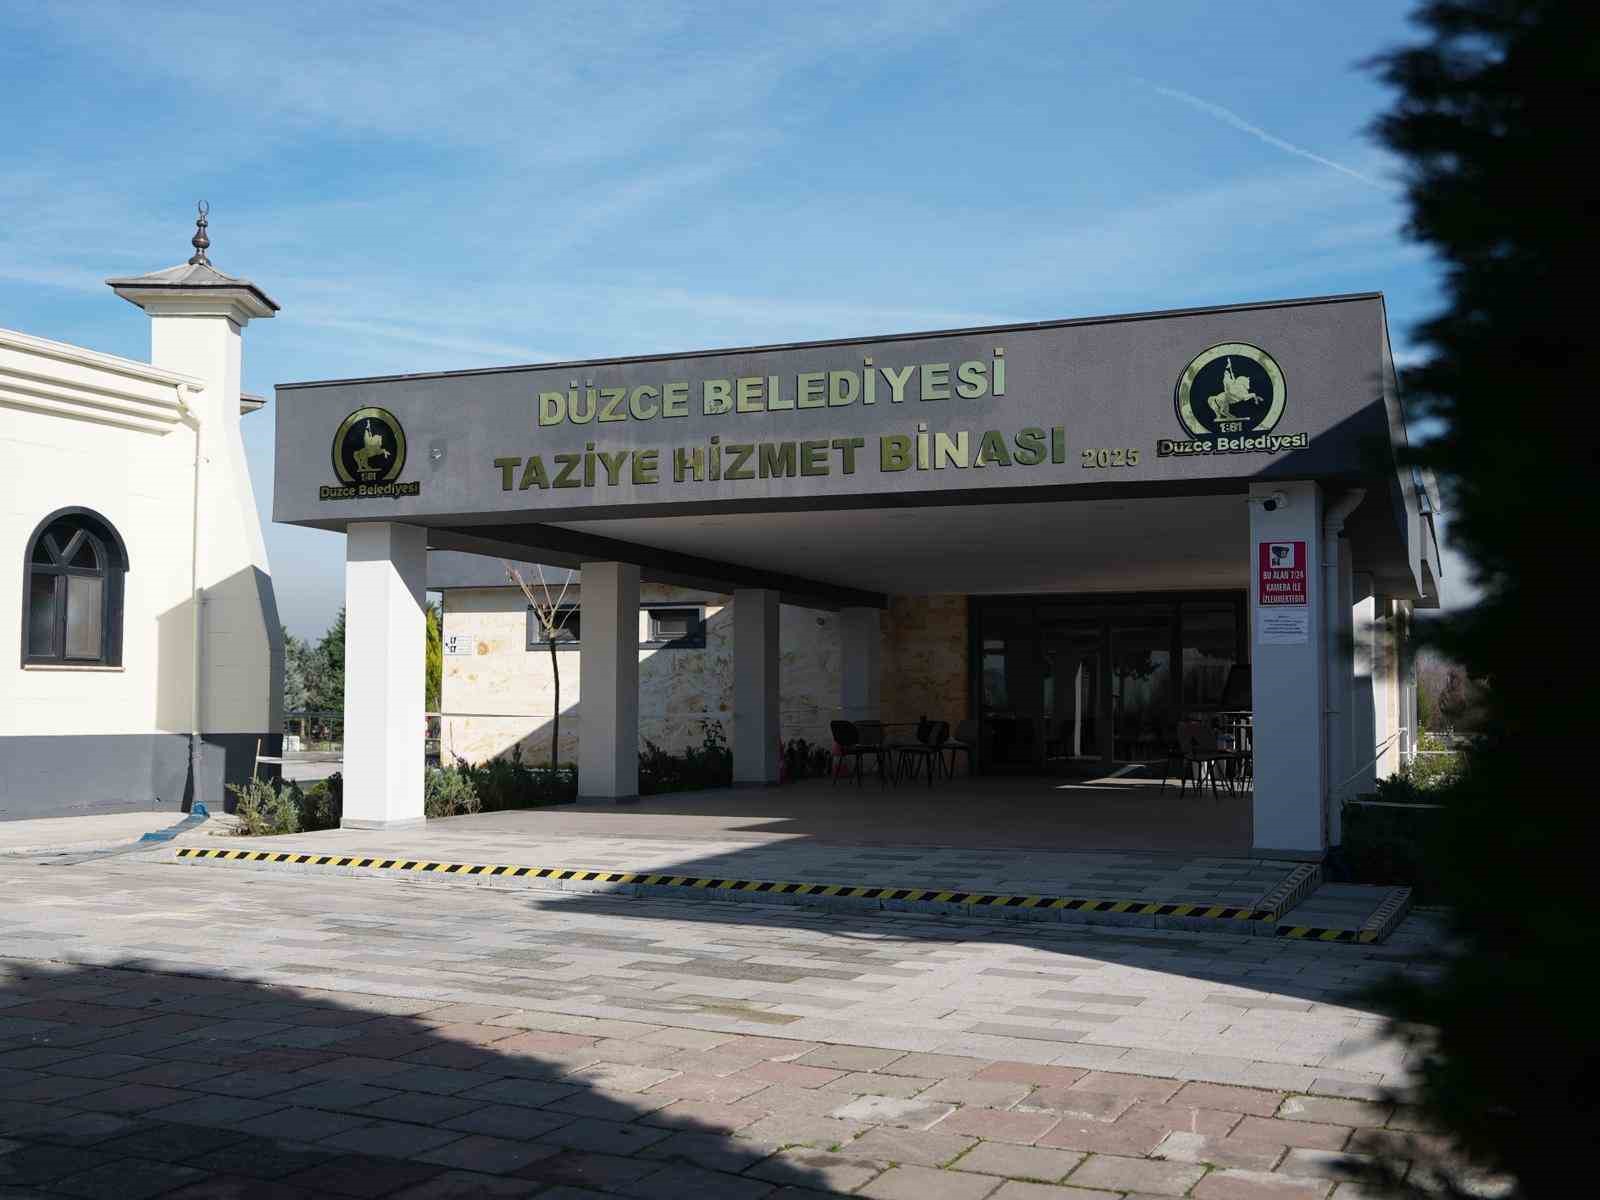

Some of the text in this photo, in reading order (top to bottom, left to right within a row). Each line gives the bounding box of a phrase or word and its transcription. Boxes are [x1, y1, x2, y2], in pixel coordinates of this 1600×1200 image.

[538, 347, 1006, 426] DÜZCE BELEDİYESİ
[494, 423, 1139, 490] TAZİYE HİZMET BİNASI 2025
[1217, 433, 1306, 451] Belediyesi
[359, 482, 418, 497] Belediyesi
